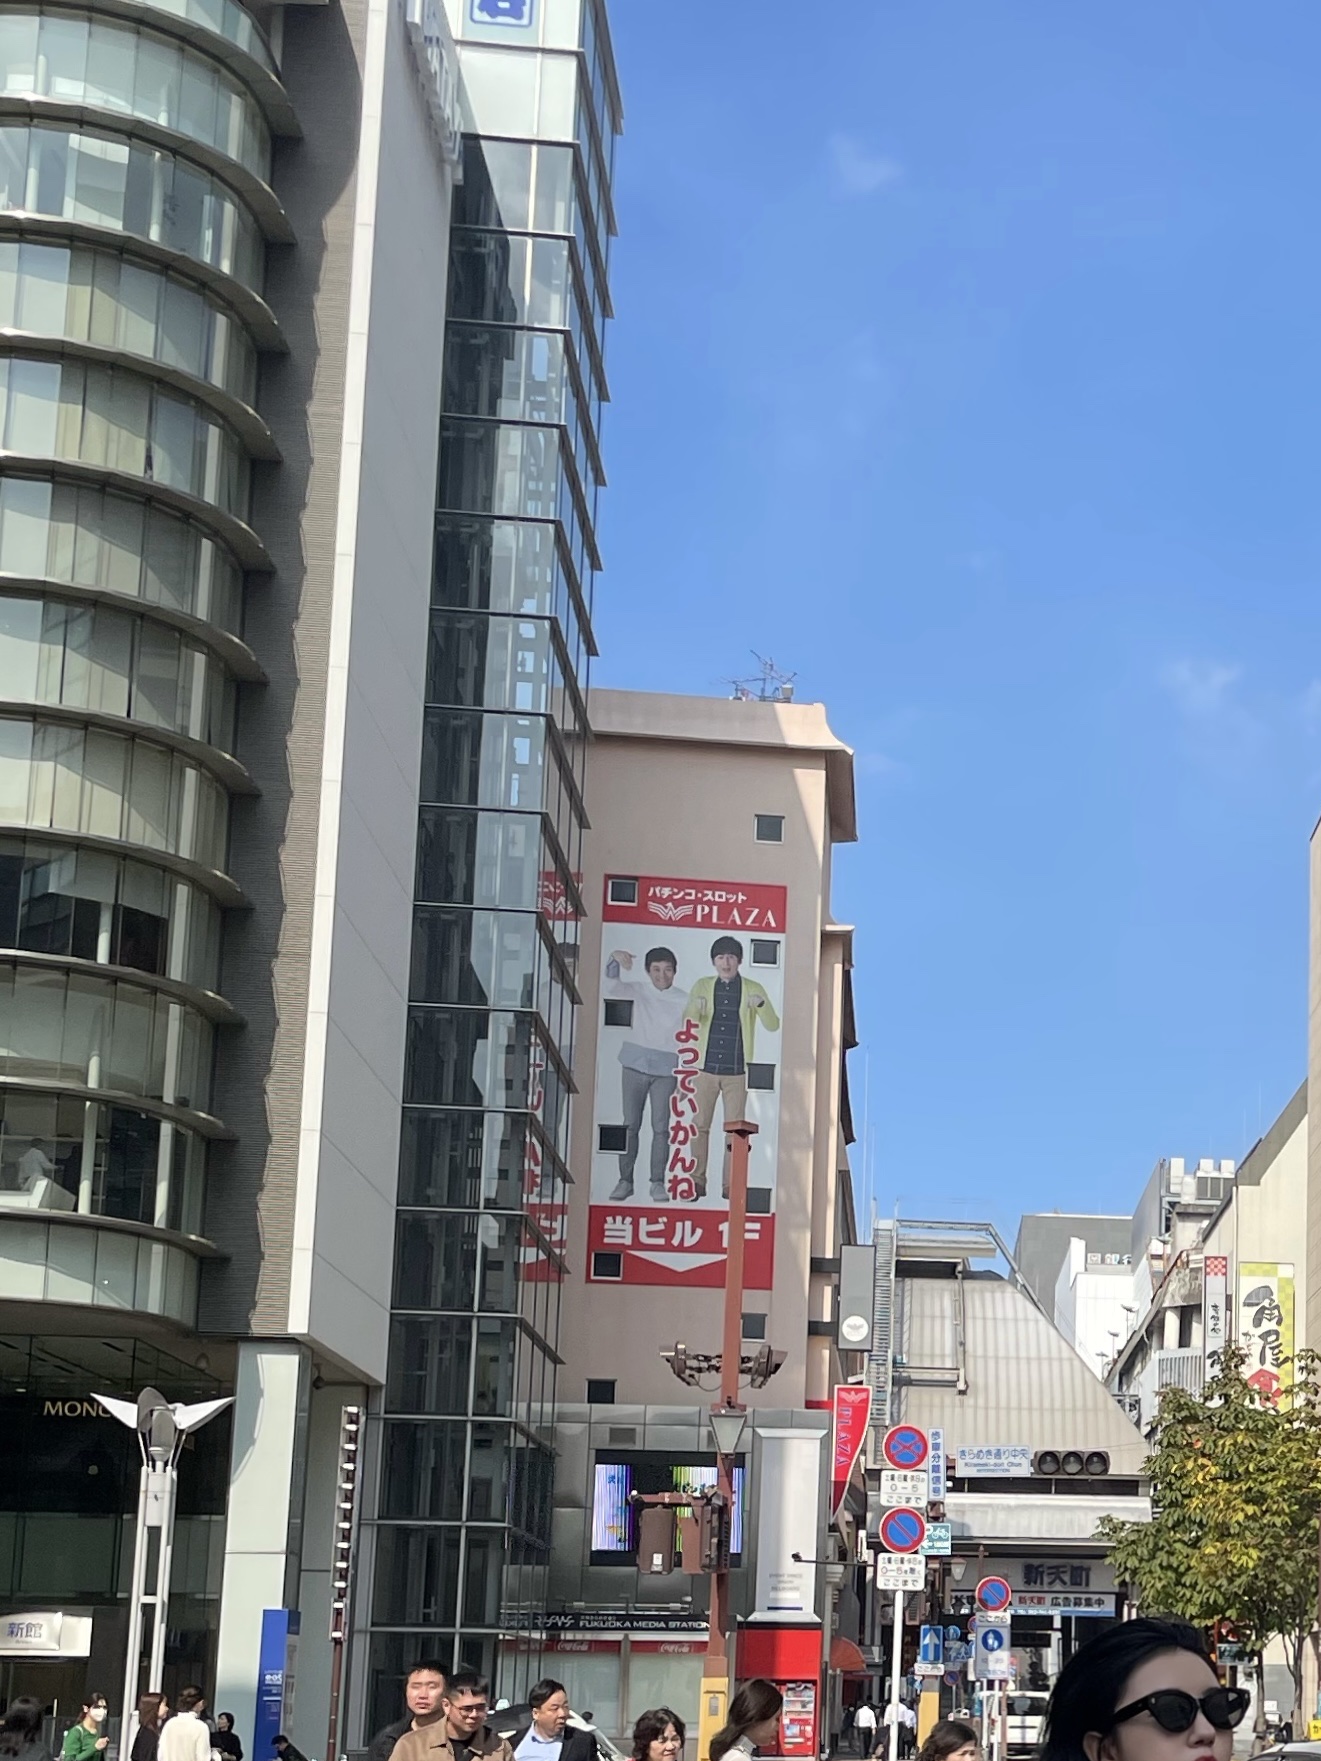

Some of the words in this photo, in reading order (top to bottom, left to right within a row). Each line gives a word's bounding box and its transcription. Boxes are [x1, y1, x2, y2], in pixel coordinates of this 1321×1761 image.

[648, 886, 748, 903] パチンコ・スロット
[695, 903, 777, 928] PLAZA
[668, 1018, 701, 1201] よっていかんね
[603, 1215, 703, 1247] 当ビル
[43, 1400, 112, 1418] MONC
[837, 1406, 853, 1467] PLAZA
[1023, 1563, 1091, 1588] 新天町
[7, 1622, 43, 1639] 新館
